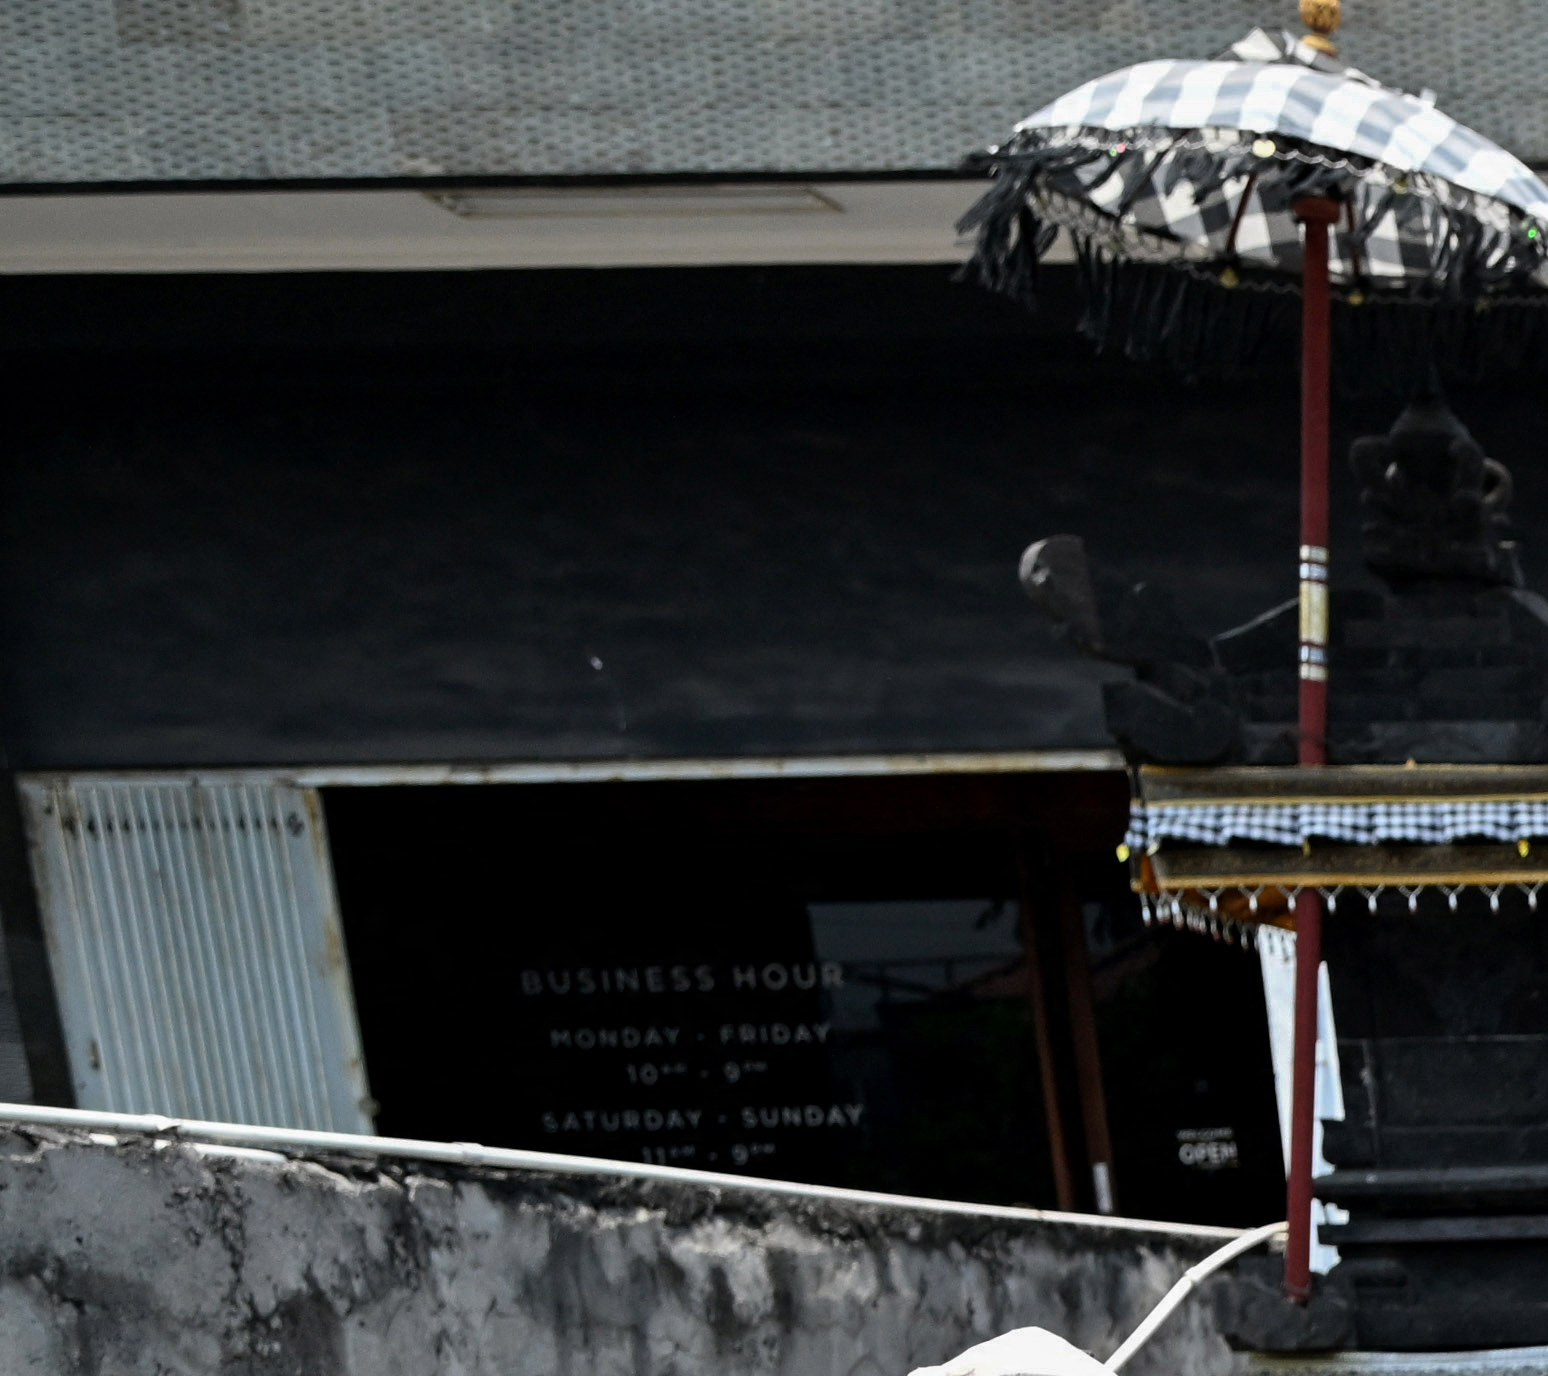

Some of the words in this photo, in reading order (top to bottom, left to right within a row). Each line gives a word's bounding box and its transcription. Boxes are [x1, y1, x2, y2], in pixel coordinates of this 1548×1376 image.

[519, 964, 715, 996] BUSINESS
[732, 961, 845, 992] HOUR
[549, 1025, 681, 1050] MONDAY
[718, 1020, 834, 1046] FRIDAY
[540, 1108, 703, 1134] SATURDAY
[740, 1103, 865, 1129] SUNDAY
